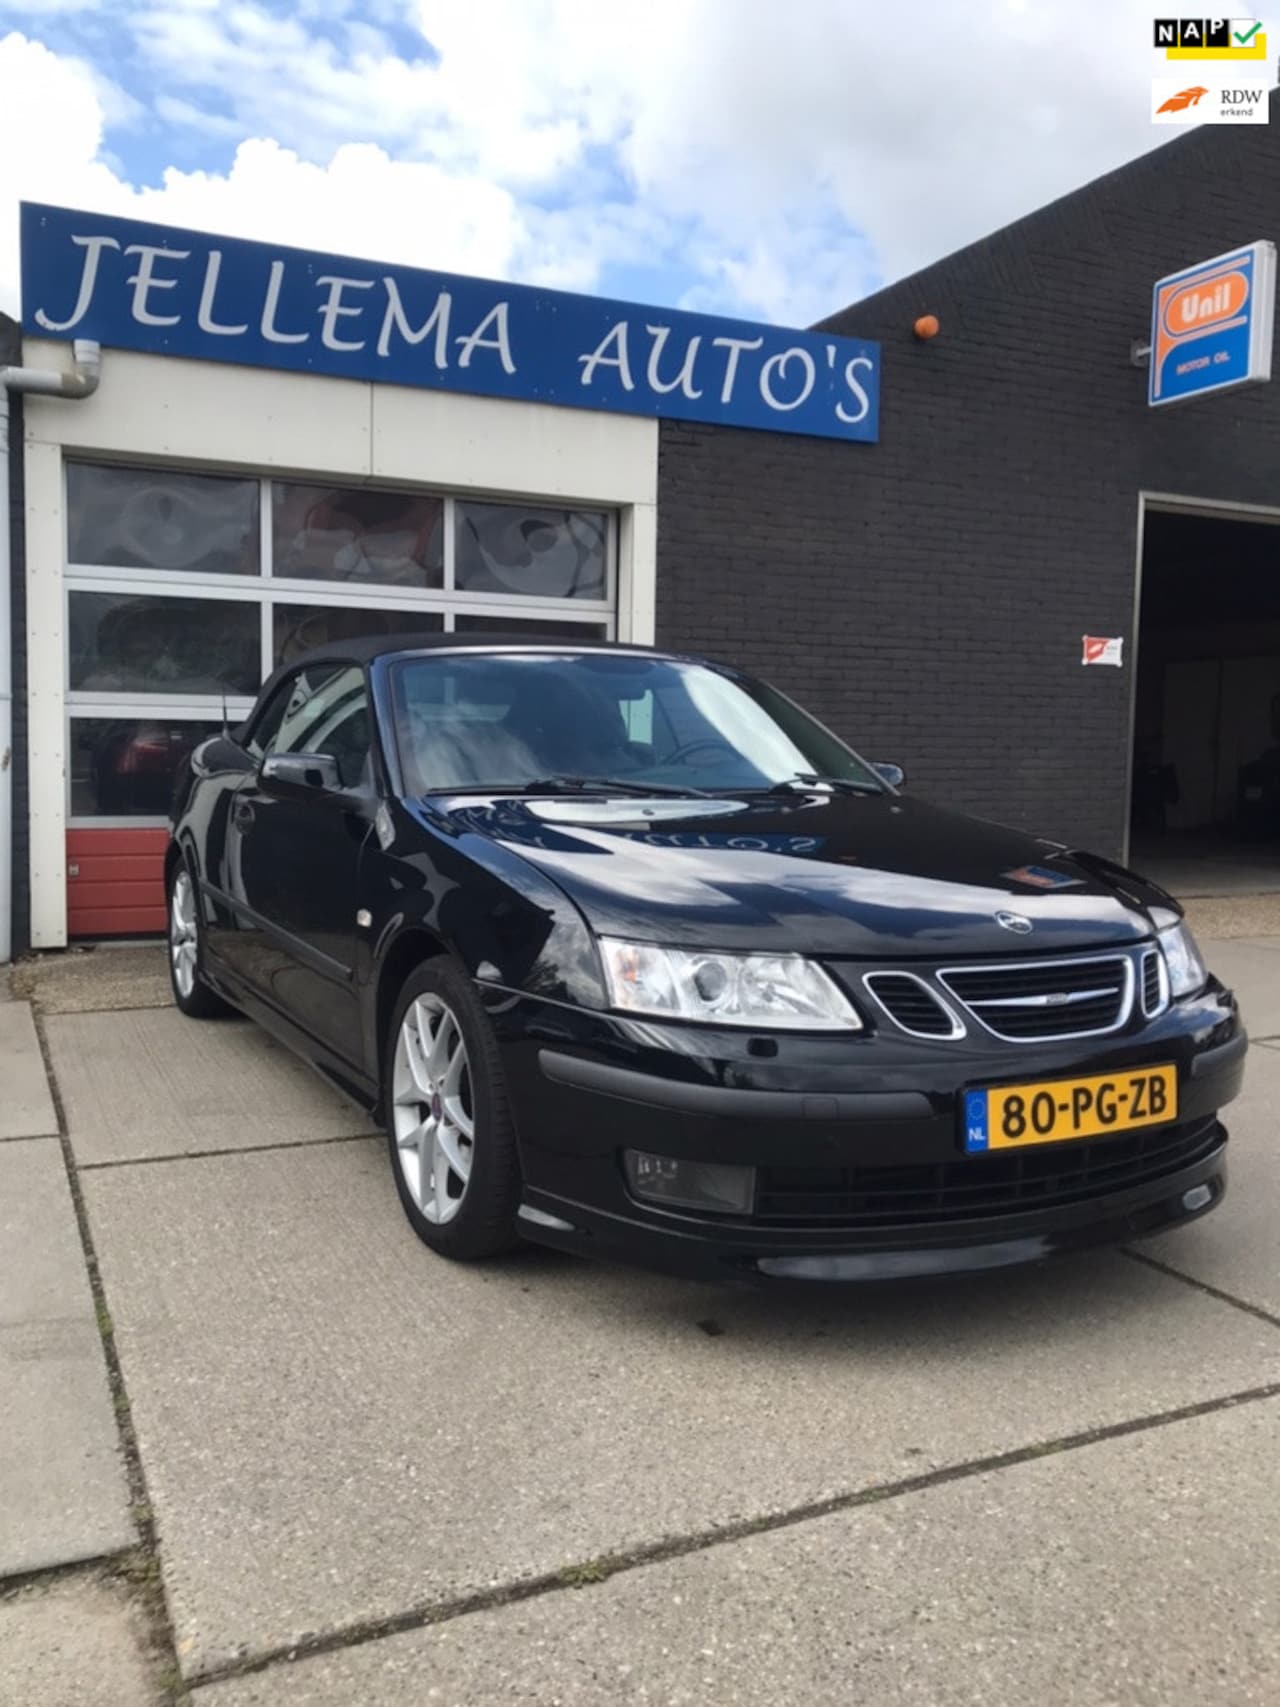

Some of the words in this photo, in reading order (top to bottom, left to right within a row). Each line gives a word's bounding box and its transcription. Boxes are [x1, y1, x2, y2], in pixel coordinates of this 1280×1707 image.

[1181, 282, 1231, 323] Unil
[34, 234, 517, 374] JELLEMA
[578, 321, 873, 423] AUTO'S
[1176, 356, 1210, 376] MOTOR
[1002, 1075, 1167, 1138] 80-PG-ZB
[968, 1127, 986, 1142] NL
